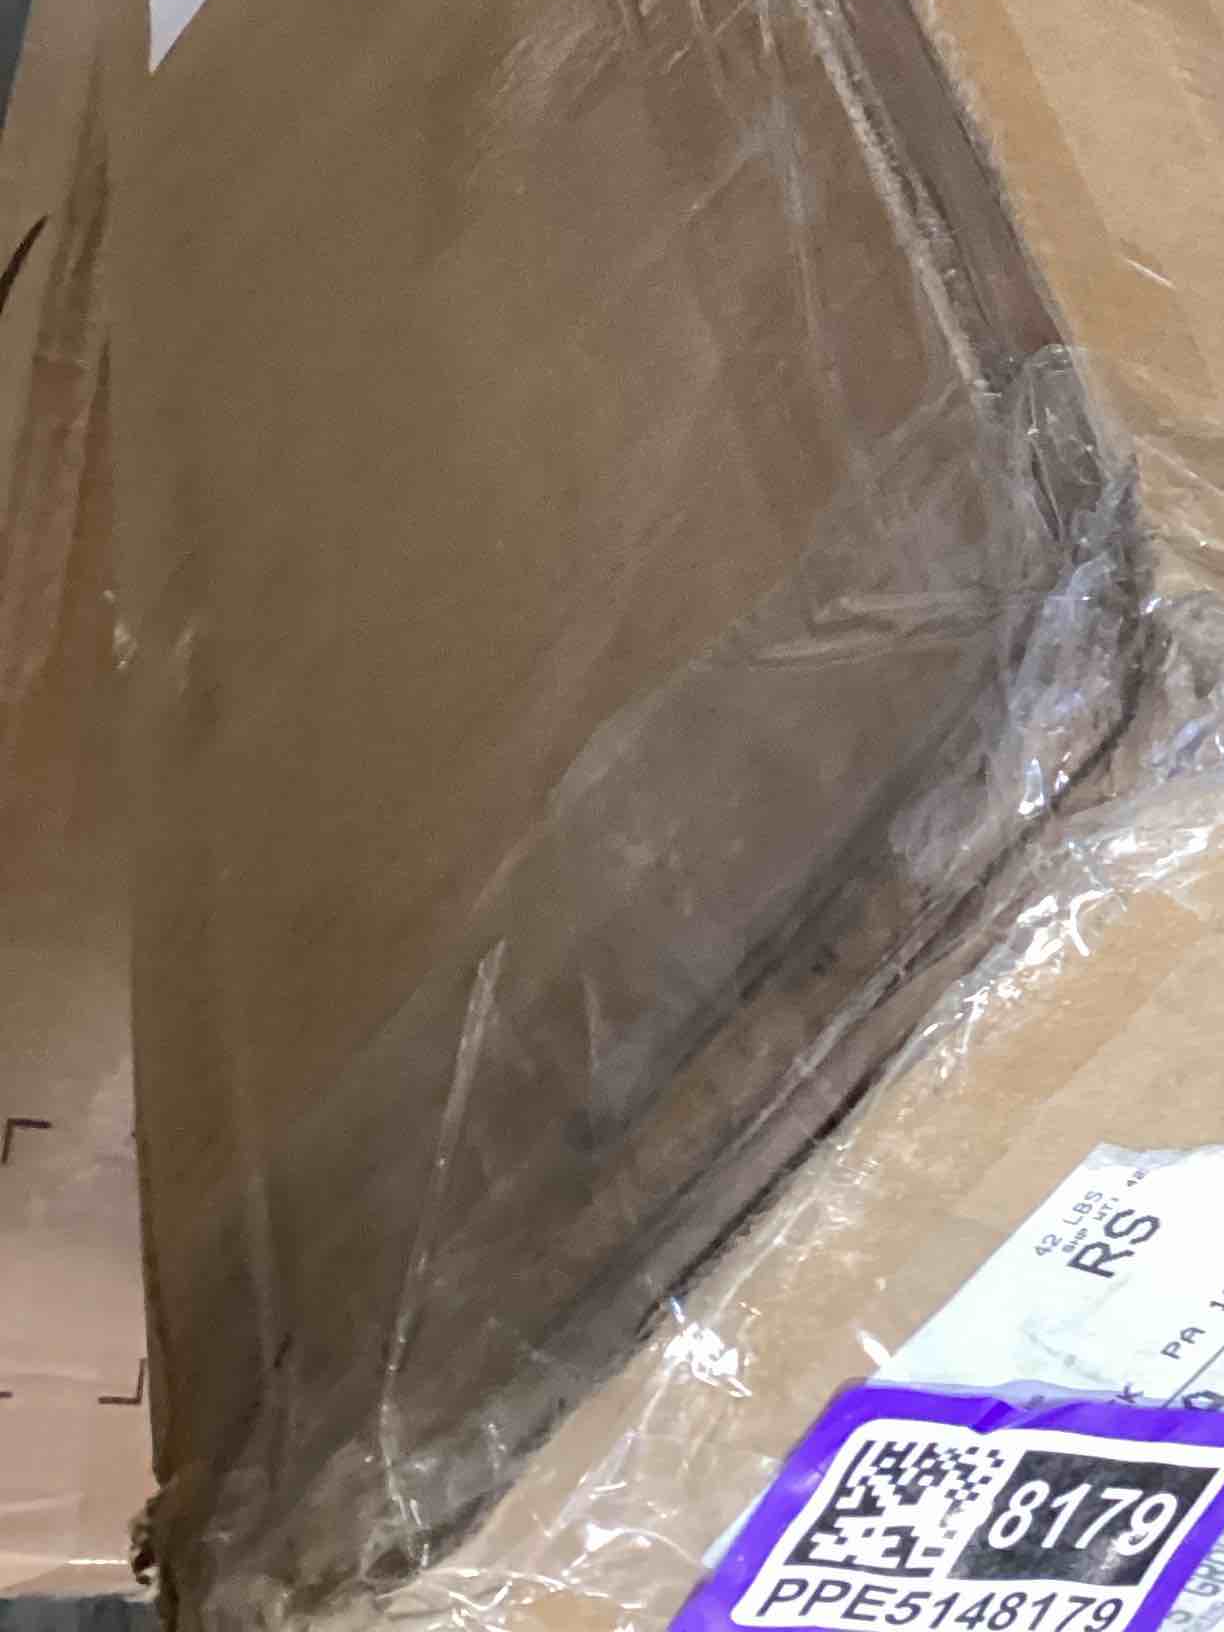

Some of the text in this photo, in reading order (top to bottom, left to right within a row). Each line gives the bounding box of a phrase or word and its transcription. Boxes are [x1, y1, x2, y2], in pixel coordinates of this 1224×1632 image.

[1034, 1190, 1103, 1257] 42 LBS
[1067, 1208, 1160, 1278] RS
[1161, 1326, 1206, 1359] PA
[986, 1478, 1178, 1557] 8179
[755, 1578, 1124, 1632] PPE5148179
